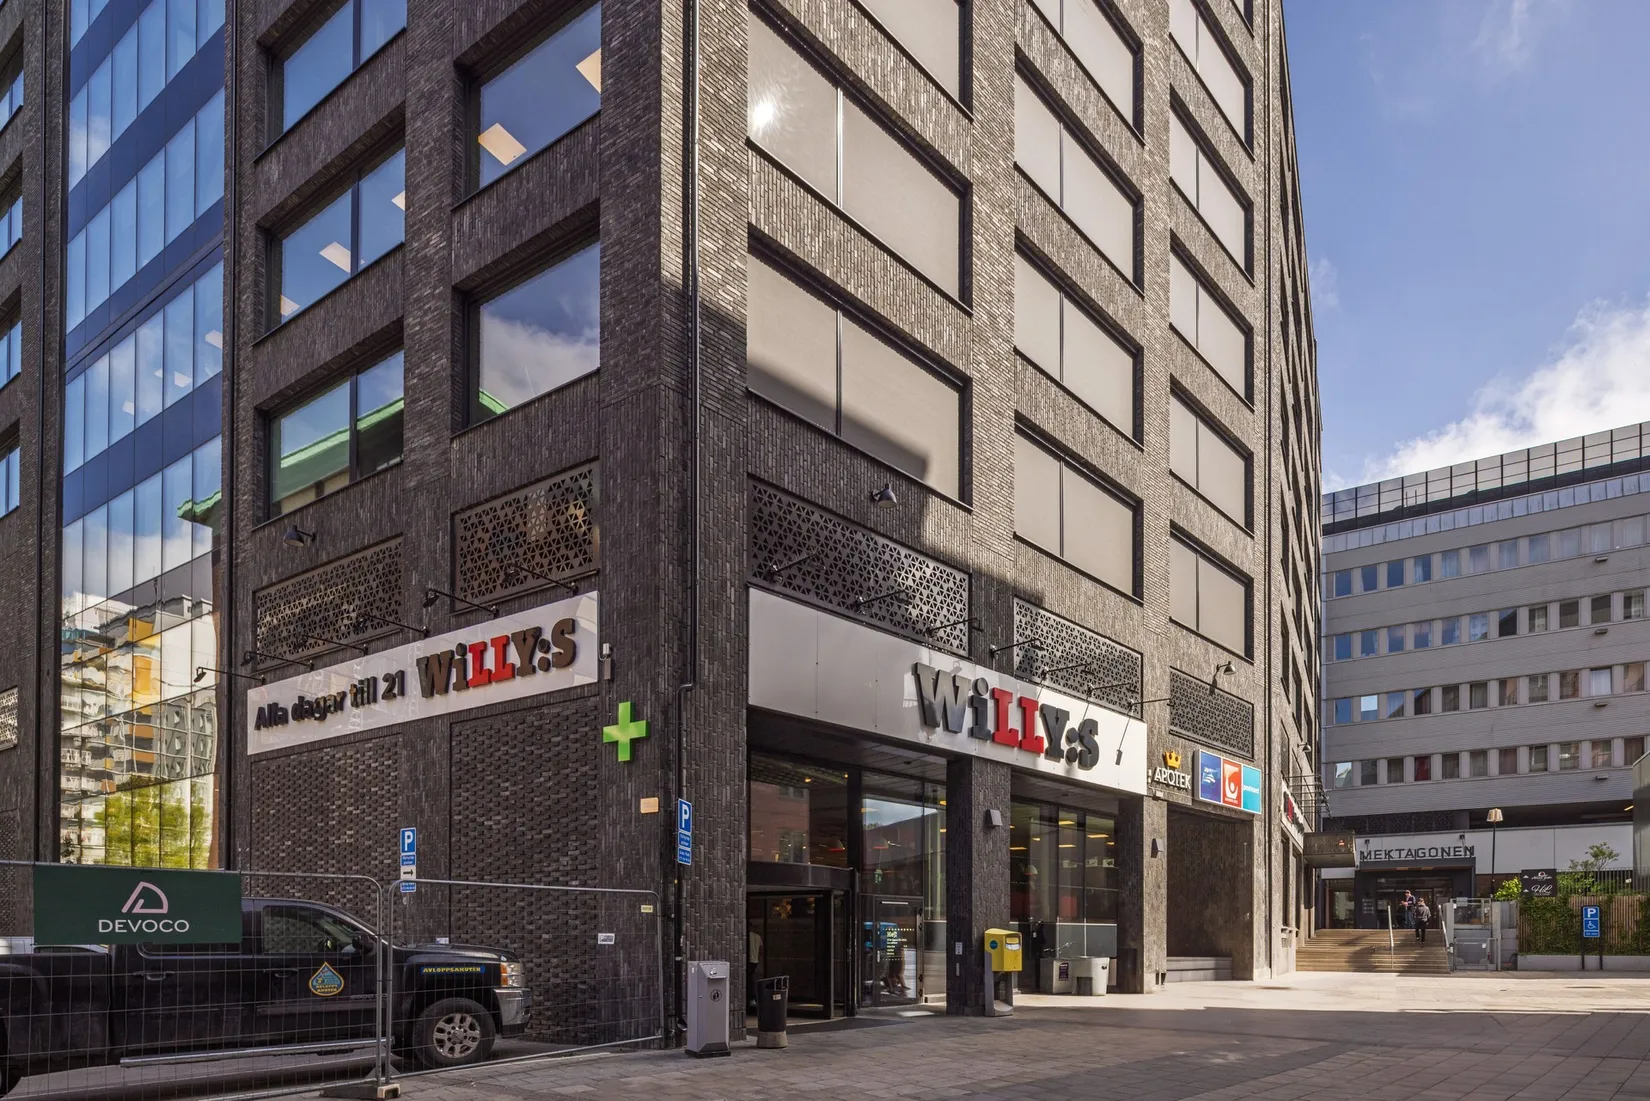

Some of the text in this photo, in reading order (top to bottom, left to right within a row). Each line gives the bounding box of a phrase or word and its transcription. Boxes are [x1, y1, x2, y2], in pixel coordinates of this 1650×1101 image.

[253, 669, 405, 731] Alla dagar till 21
[1153, 767, 1191, 790] APOTEK
[682, 803, 690, 828] P
[404, 831, 413, 851] P
[1360, 846, 1475, 861] MEKTAGONEN
[1587, 908, 1596, 918] P
[98, 919, 190, 933] DEVOCO
